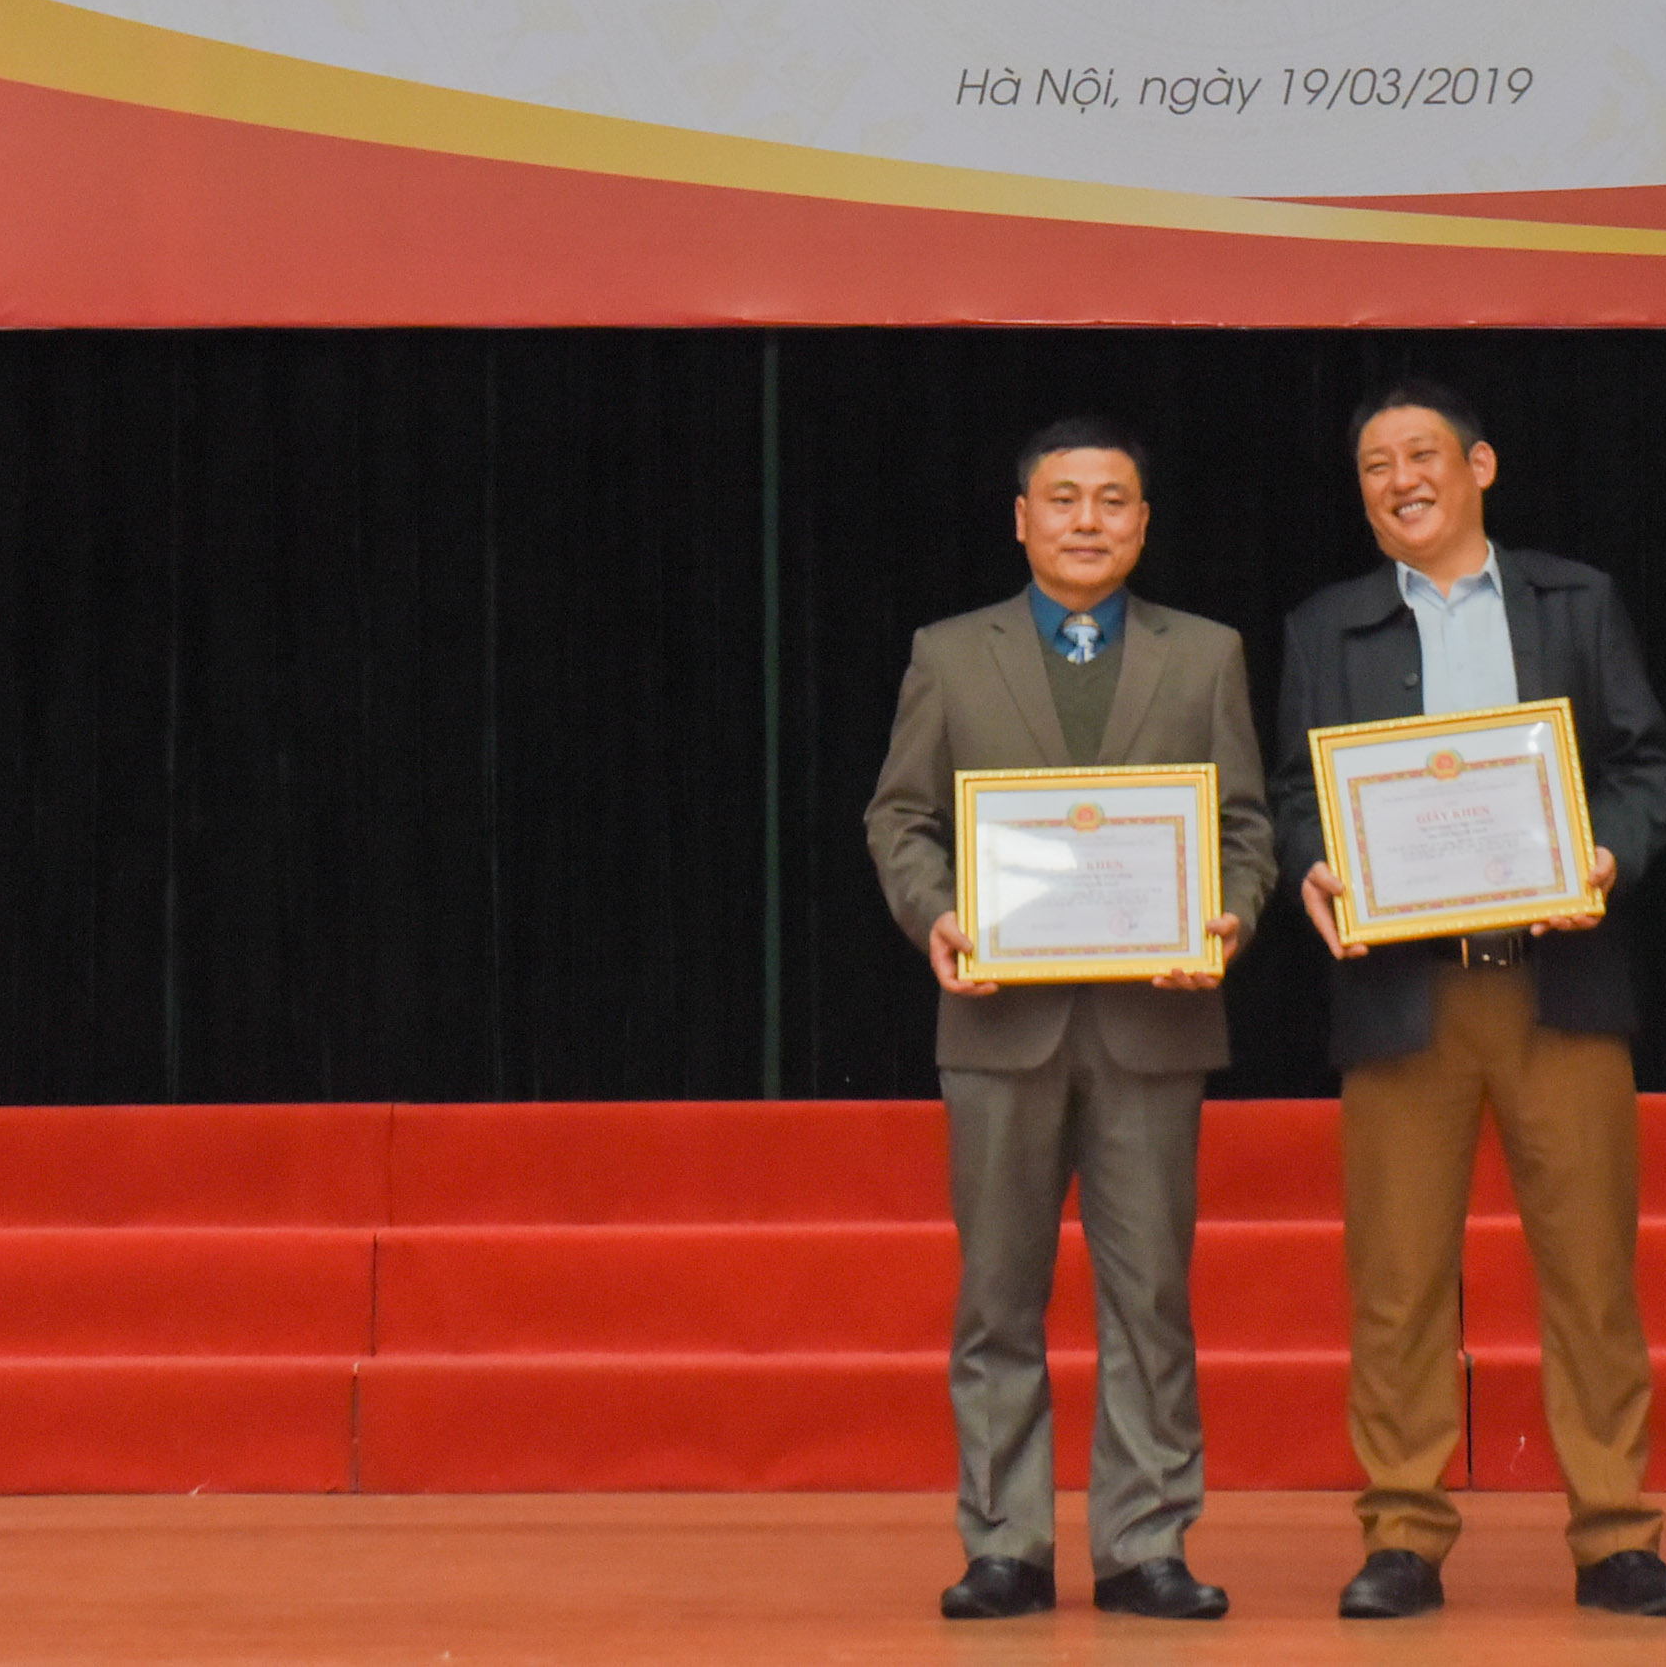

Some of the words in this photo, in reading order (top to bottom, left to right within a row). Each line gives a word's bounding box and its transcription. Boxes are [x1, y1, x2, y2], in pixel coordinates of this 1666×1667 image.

[956, 66, 1022, 106] Hà
[1035, 67, 1119, 115] Nội,
[1138, 66, 1262, 116] ngày
[1283, 66, 1534, 111] 19/03/2019
